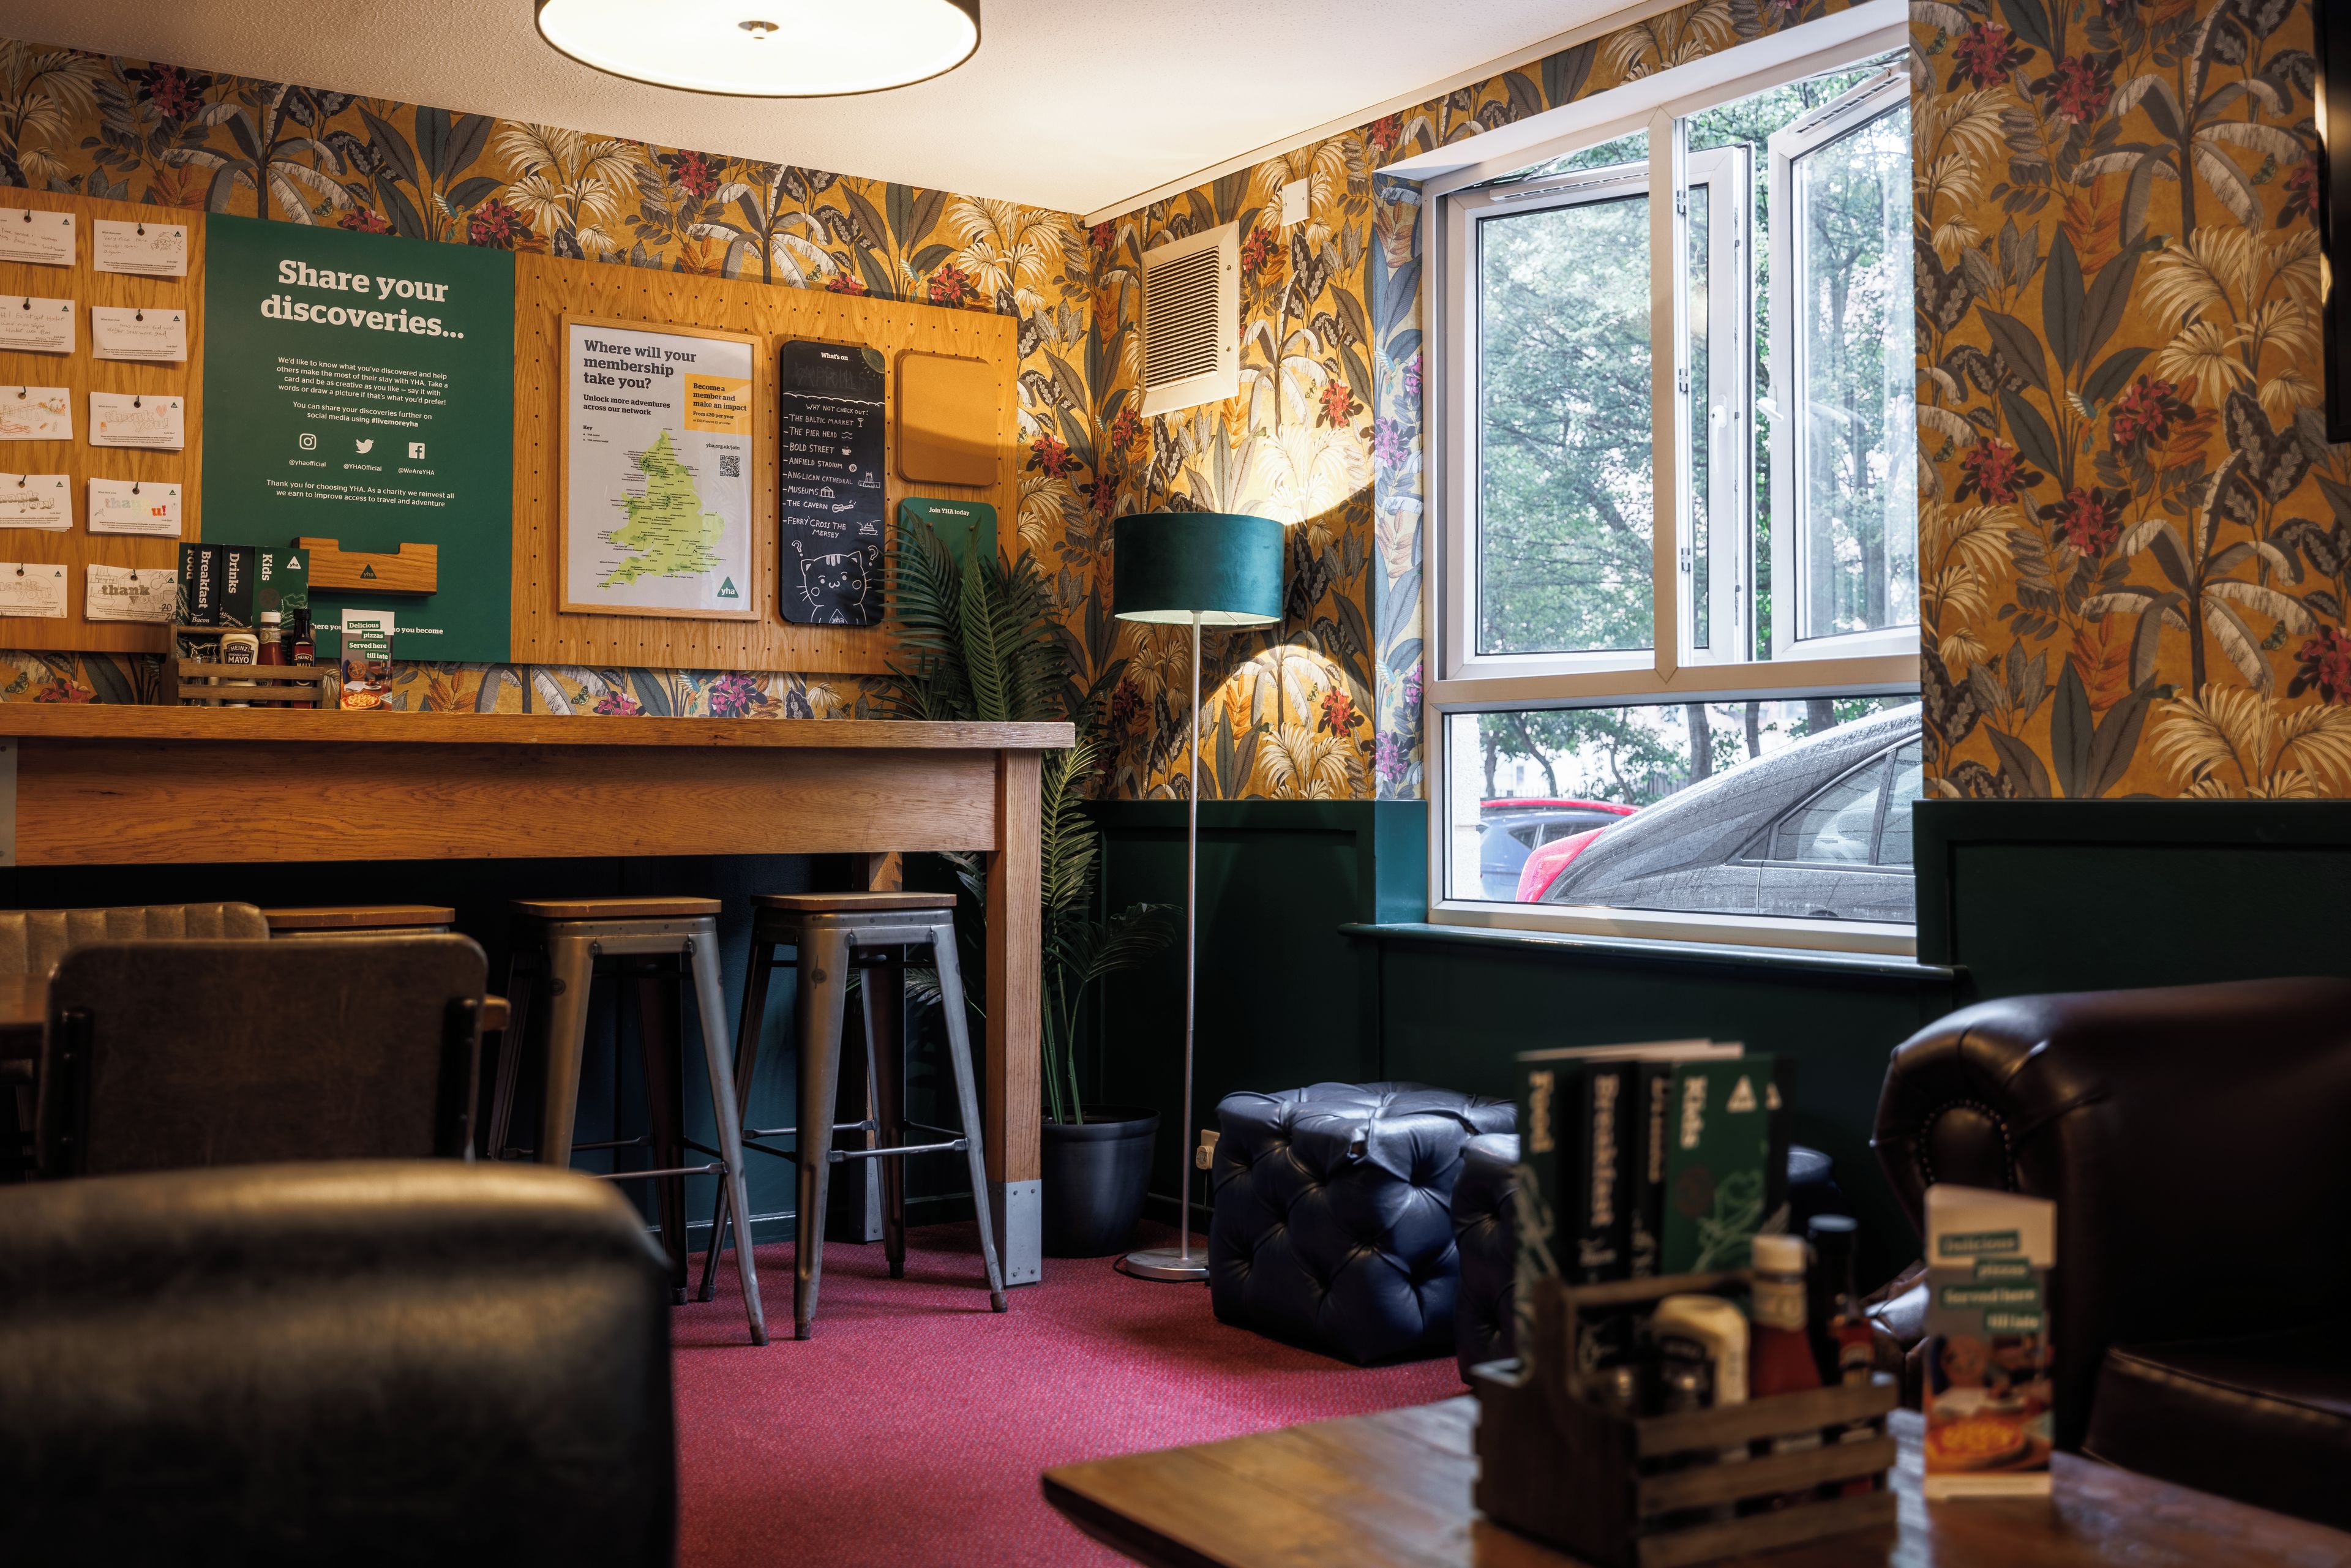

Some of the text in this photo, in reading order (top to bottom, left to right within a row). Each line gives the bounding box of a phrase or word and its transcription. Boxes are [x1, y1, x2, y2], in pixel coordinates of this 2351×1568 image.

[279, 260, 448, 302] Share your
[261, 294, 464, 338] discoveries...
[584, 339, 696, 364] Where will your
[381, 367, 417, 376] discovered
[584, 358, 673, 377] membership
[583, 372, 651, 389] take you?
[693, 382, 720, 391] Become
[583, 394, 609, 402] Unlock
[631, 399, 670, 408] adventures
[359, 408, 397, 416] discoveries
[371, 417, 418, 427] #livemoreyha
[789, 414, 803, 422] THE
[789, 426, 802, 436] THE
[789, 442, 834, 453] BOLD STREET
[789, 457, 842, 468] ANFIELD STADIUM
[787, 471, 852, 484] ANGLICAN CATHEDRAL
[316, 483, 347, 492] choosing
[787, 486, 819, 495] MUSEUMS
[803, 501, 828, 509] CAVERN
[812, 529, 839, 538] MERSEY
[261, 553, 273, 581] Kids
[228, 553, 240, 594] Drinks
[198, 550, 212, 609] Breakfast
[102, 585, 150, 595] thank
